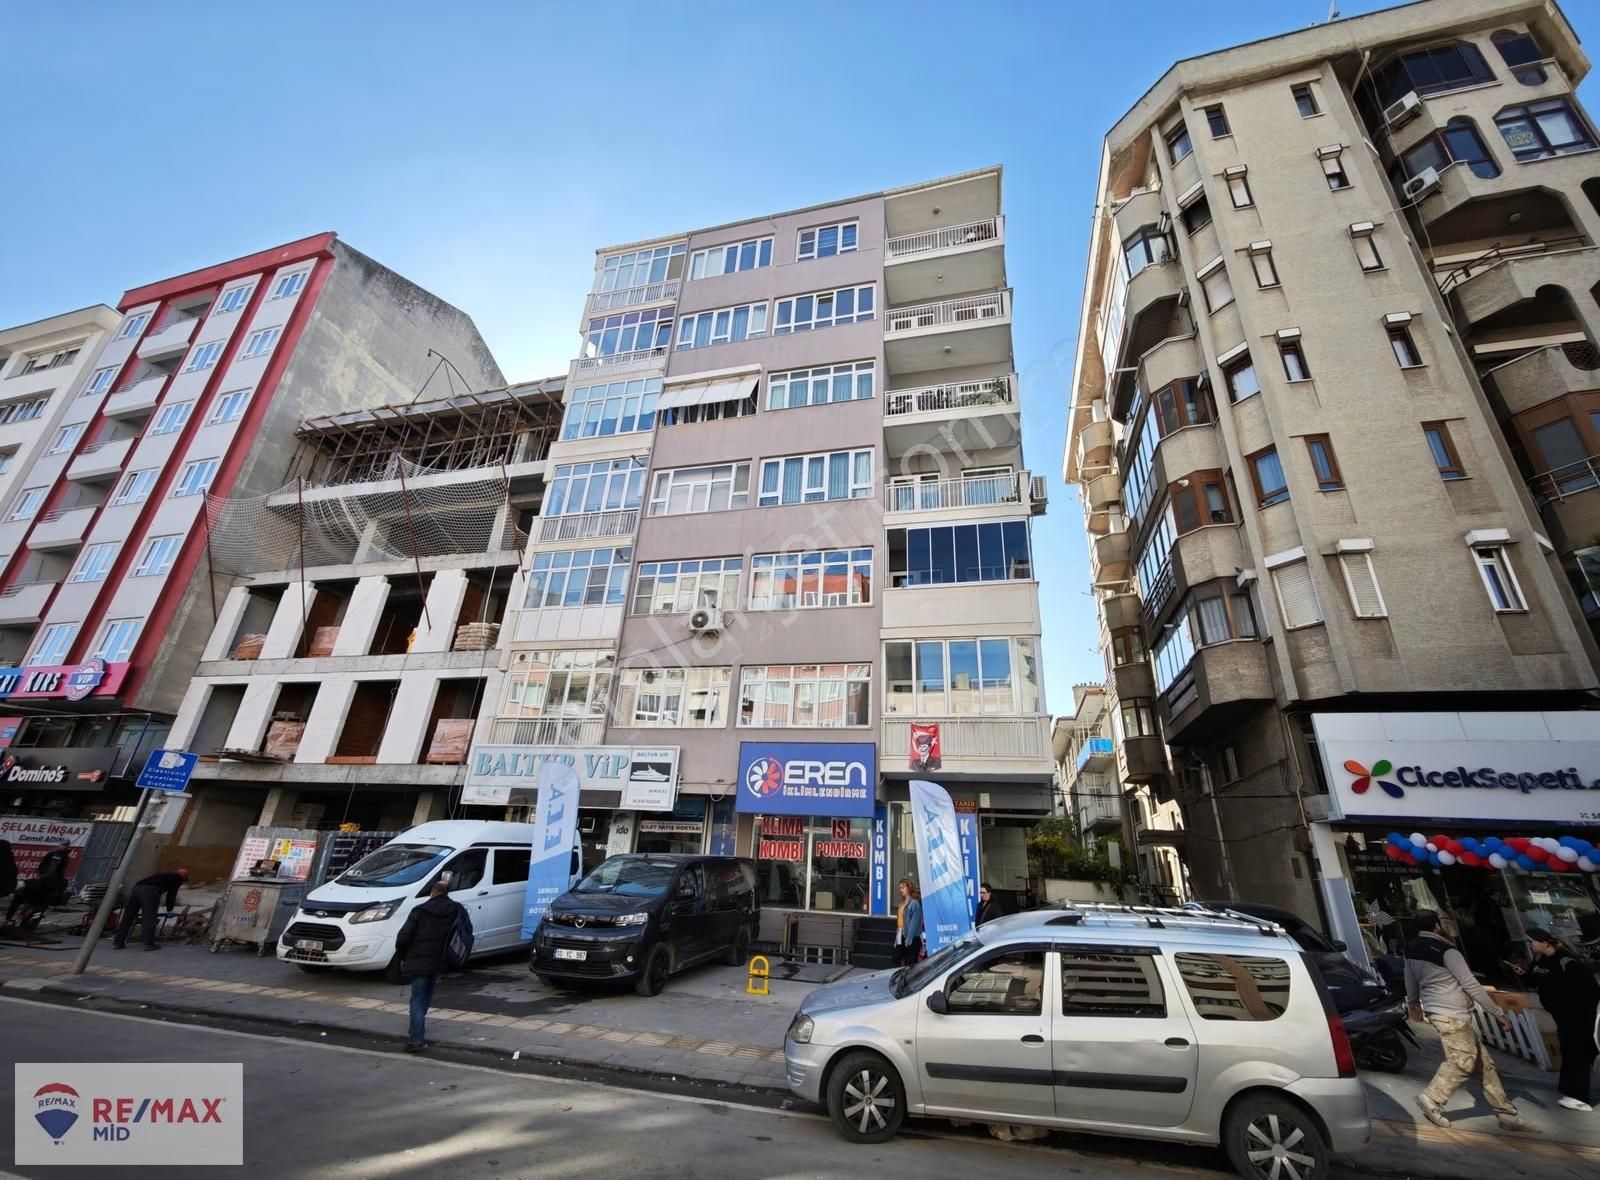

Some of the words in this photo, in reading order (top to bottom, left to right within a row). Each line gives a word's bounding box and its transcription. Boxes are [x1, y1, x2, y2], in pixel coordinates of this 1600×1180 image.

[24, 672, 61, 691] KURS
[76, 674, 95, 684] VIP
[8, 765, 65, 782] Domino's
[784, 761, 867, 786] EREN
[783, 785, 867, 798] İKLİMLENDİRME
[1, 822, 47, 833] ŞELALE
[48, 823, 89, 836] İNŞAAT
[616, 824, 629, 835] ido
[832, 819, 851, 840] ISI
[759, 838, 804, 861] KOMBİ
[816, 841, 867, 858] POMPASI
[874, 820, 886, 899] KOMBİ
